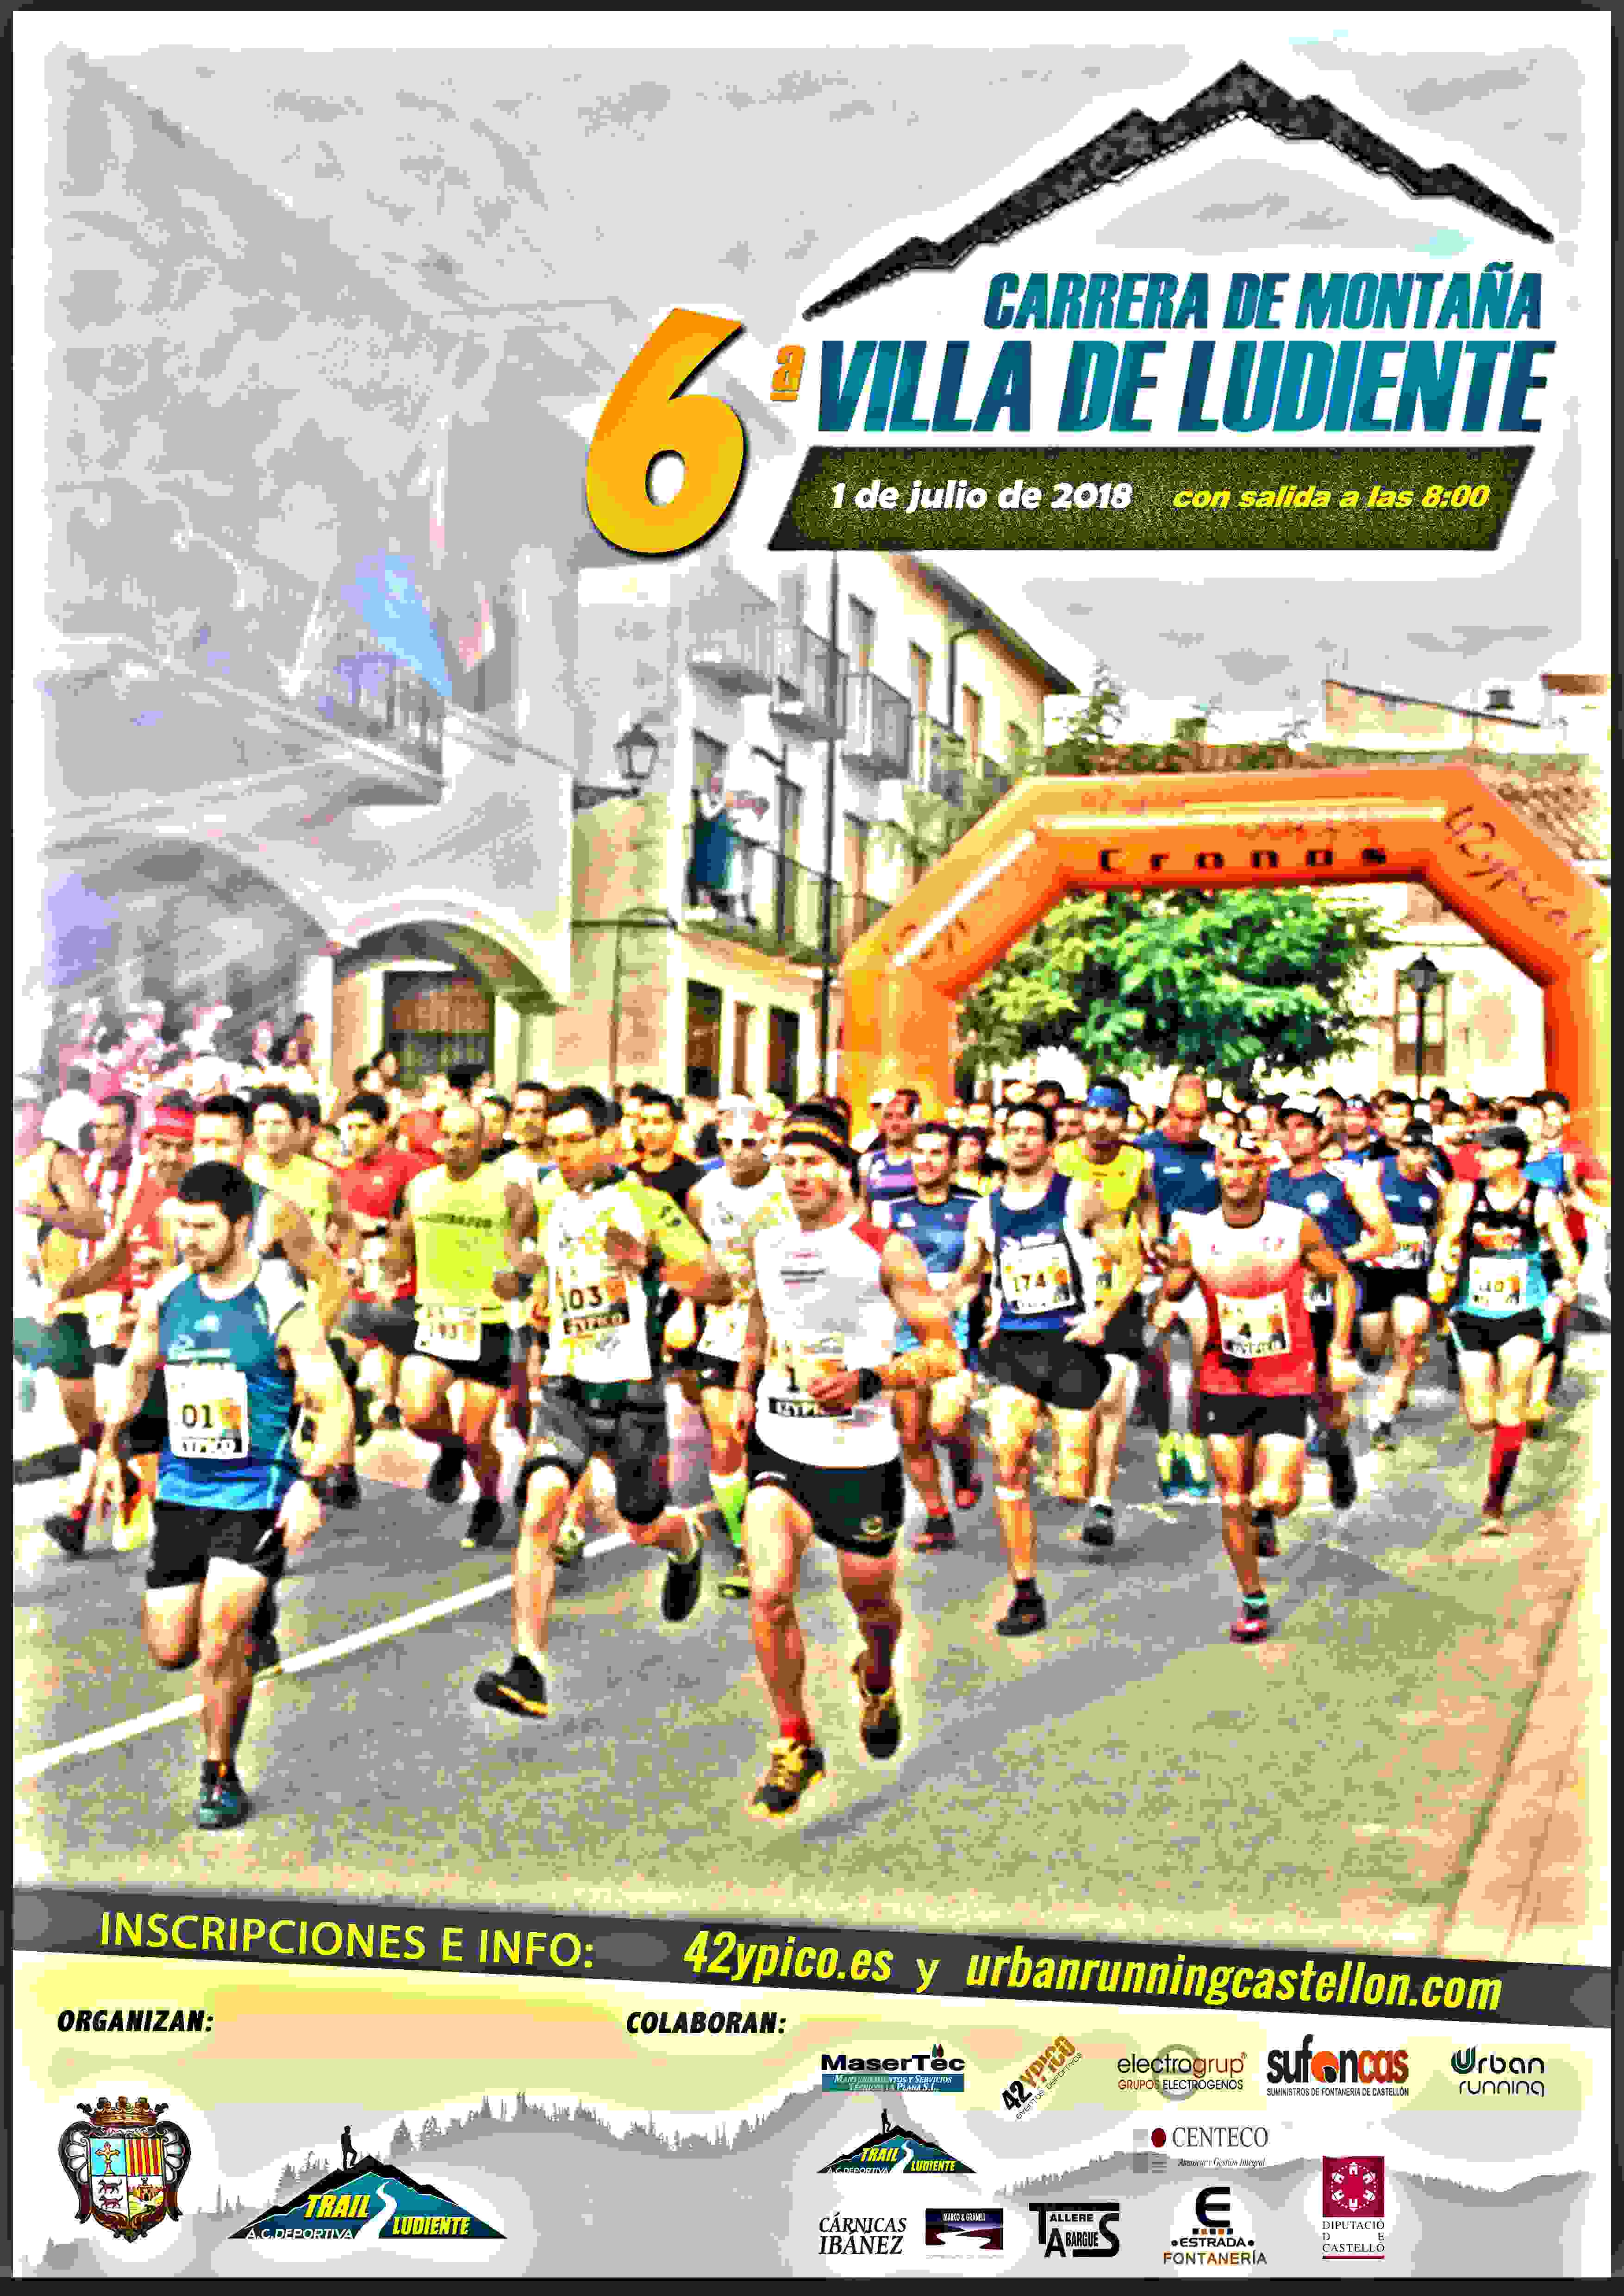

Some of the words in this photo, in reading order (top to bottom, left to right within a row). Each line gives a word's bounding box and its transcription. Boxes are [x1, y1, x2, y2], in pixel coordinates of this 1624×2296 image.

[984, 272, 1209, 329] CARRERA
[1222, 273, 1289, 329] DE
[1295, 262, 1543, 329] MONTAÑA
[818, 340, 1032, 431] VILLA
[1057, 340, 1166, 431] DE
[1178, 340, 1557, 433] LUDIENTE
[832, 481, 845, 508] 1
[856, 480, 899, 509] de
[906, 480, 987, 513] julio
[998, 480, 1042, 509] de
[1051, 482, 1134, 509] 2018
[1173, 488, 1230, 508] con
[1239, 485, 1330, 508] salida
[1339, 489, 1359, 508] a
[1367, 485, 1415, 508] las
[1422, 484, 1491, 508] 8:00
[99, 1911, 425, 1960] INSCRIPCIONES
[441, 1927, 463, 1963] E
[479, 1929, 594, 1968] INFO:
[684, 1930, 893, 1984] 42ypico.es
[914, 1958, 941, 1993] y
[965, 1945, 1504, 2010] urbanrunningcastellon.com
[57, 2010, 215, 2033] ORGANIZAN:
[626, 2011, 787, 2034] COLABORAN:
[821, 2054, 966, 2071] MaserTec
[1267, 2088, 1310, 2096] SUMINISTROS
[1311, 2088, 1319, 2096] DE
[1362, 2088, 1371, 2096] DE
[1173, 2127, 1268, 2147] CENTECO
[860, 2147, 899, 2163] TRAIL
[910, 2159, 956, 2172] LUDIENTE
[304, 2194, 371, 2219] TRAIL
[392, 2215, 471, 2236] LUDIENTE
[818, 2211, 907, 2234] CÁRNICAS
[943, 2213, 960, 2221] MARCO
[1322, 2218, 1385, 2229] DIPUTACIÓ
[1180, 2238, 1246, 2248] ESTRADA
[1322, 2241, 1385, 2252] CASTELLÓ
[1163, 2250, 1267, 2265] FONTANERÍA
